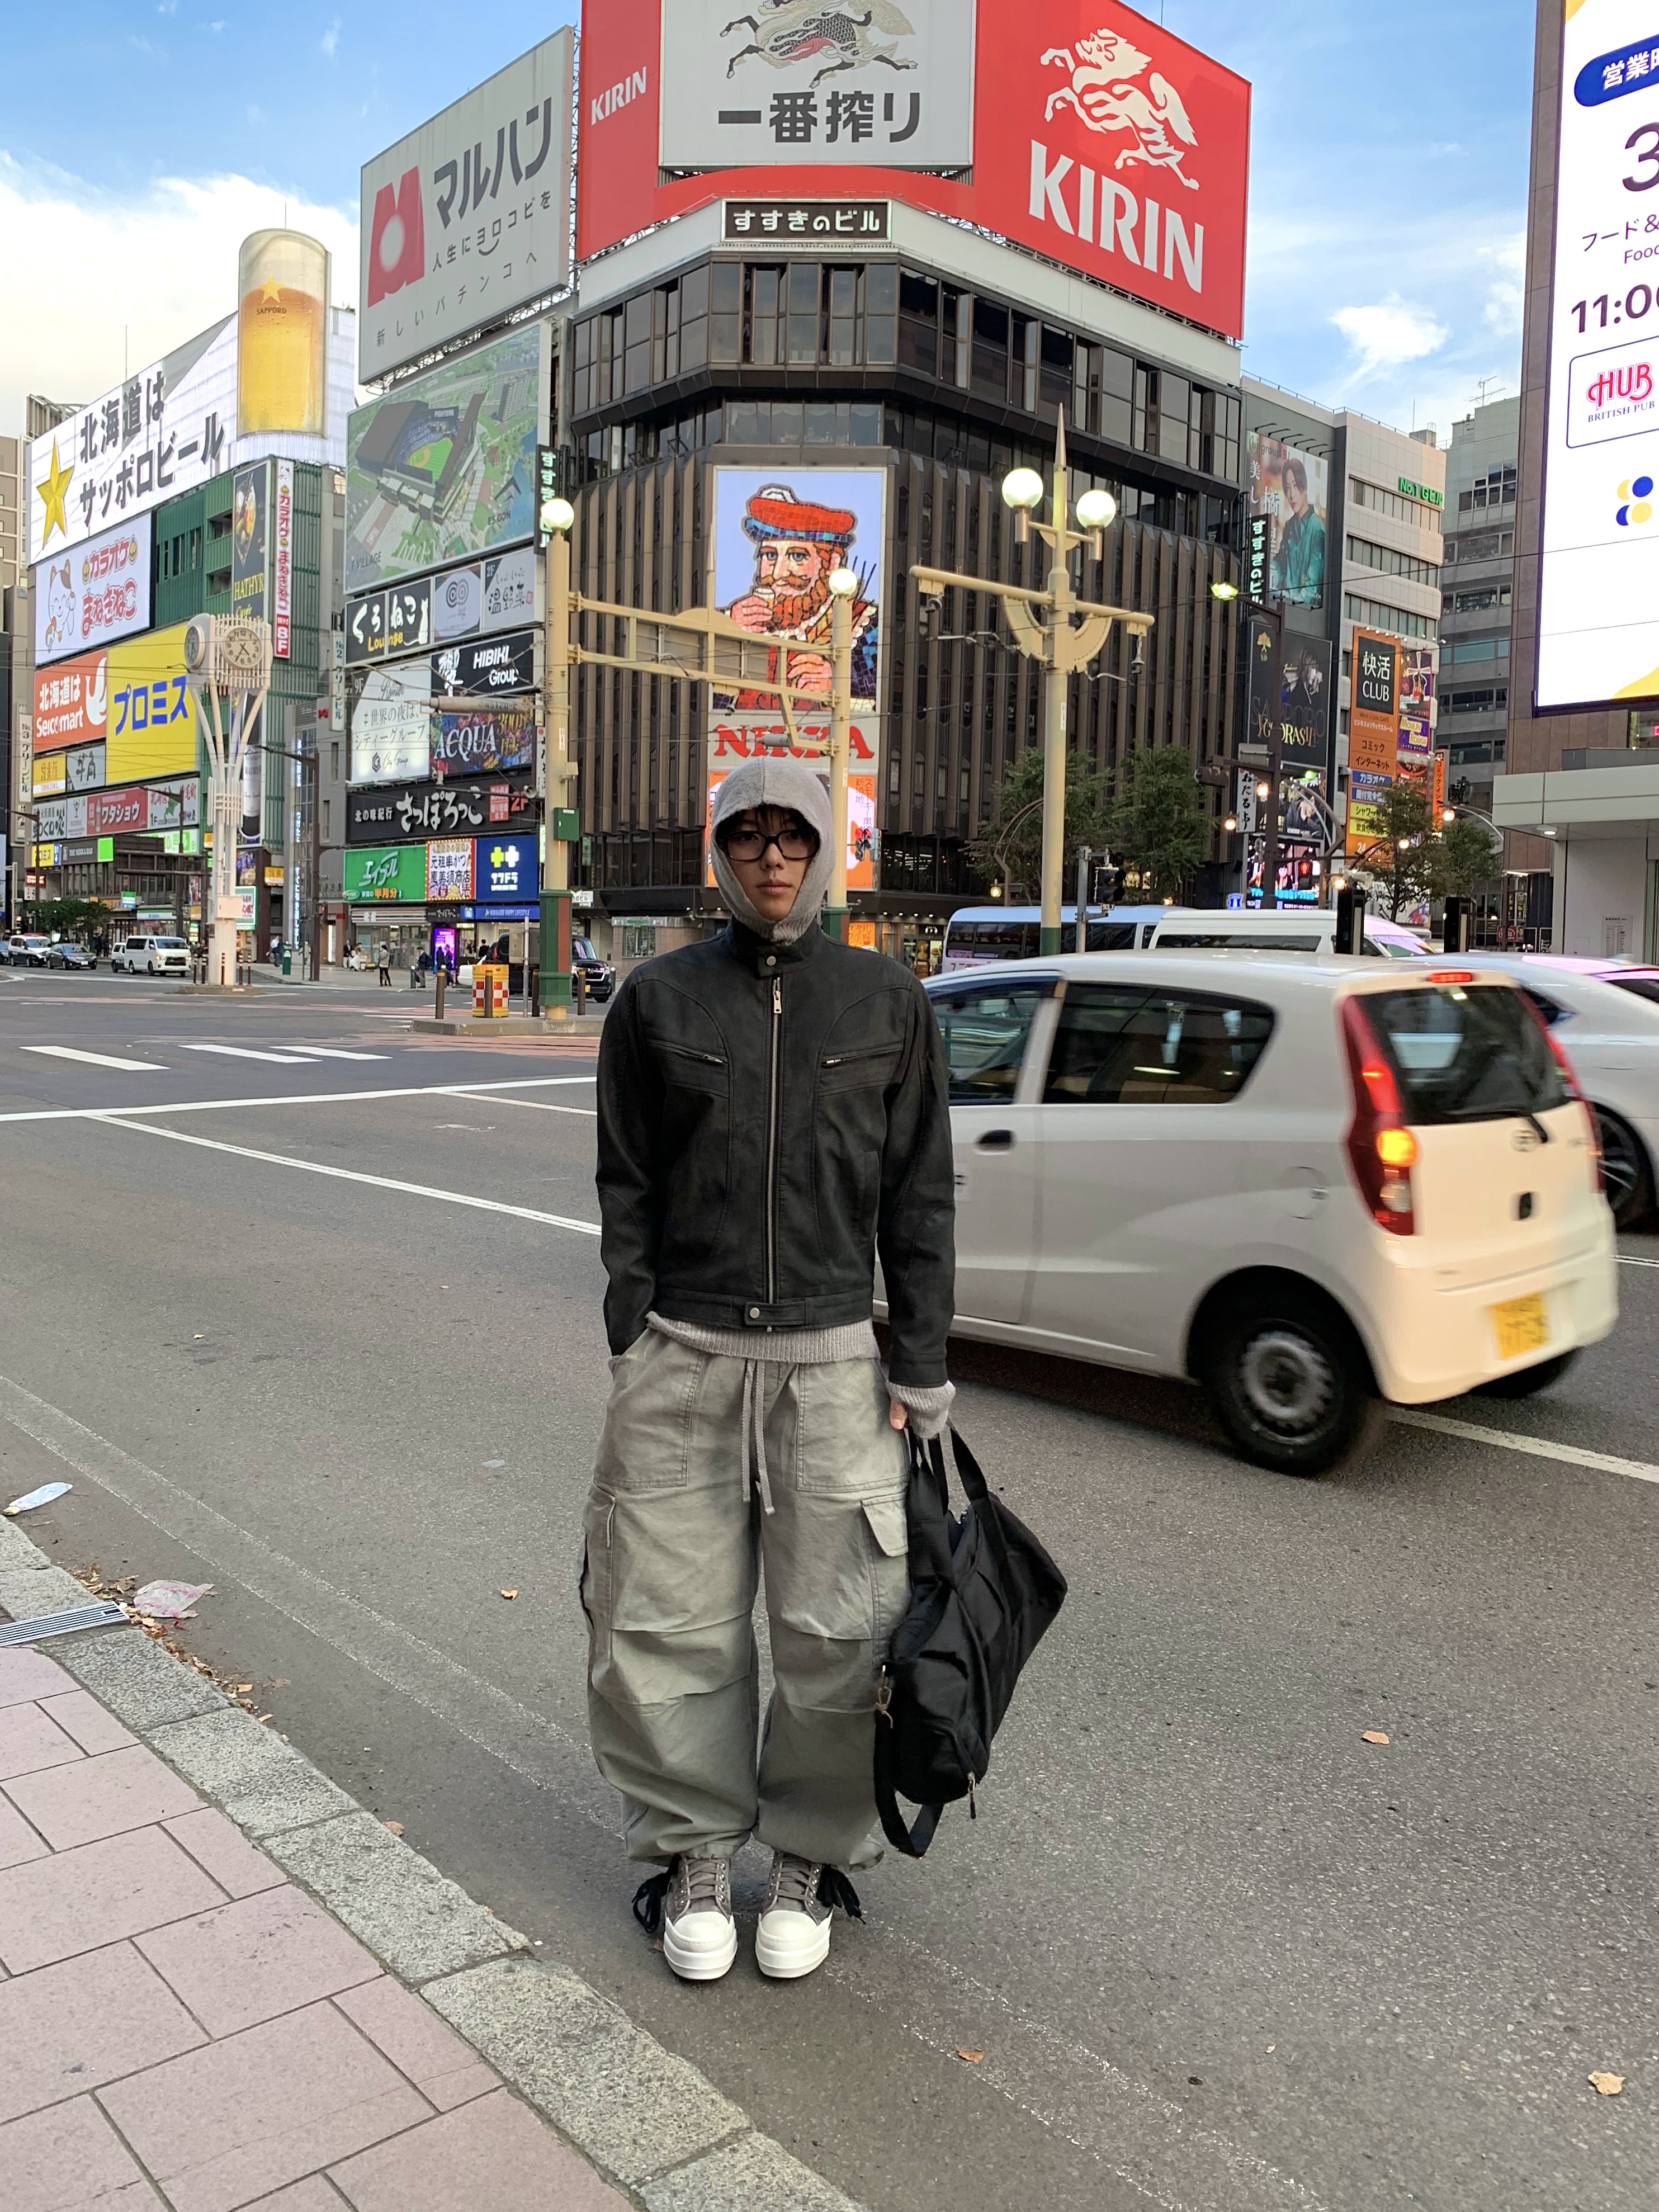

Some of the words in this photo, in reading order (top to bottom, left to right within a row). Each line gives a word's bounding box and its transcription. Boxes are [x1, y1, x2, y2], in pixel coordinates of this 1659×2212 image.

[590, 66, 647, 126] KIRIN
[718, 91, 921, 143] 一番搾り
[434, 96, 552, 230] マルハン
[432, 190, 551, 273] 人生にヨロコビを
[733, 210, 881, 232] すすきのビル
[1029, 139, 1204, 294] KIRIN
[256, 306, 287, 315] SAPPORO
[1571, 284, 1659, 333] 11:0
[1587, 362, 1654, 410] HUB
[80, 370, 167, 464] 北海道は
[1587, 407, 1630, 422] BRITISH
[1634, 400, 1655, 413] PUB
[80, 411, 225, 528] サッポロビール
[279, 494, 291, 538] カラオケ
[89, 537, 130, 584] カラオケ
[356, 551, 382, 570] VILLAGE
[486, 565, 495, 577] 2F
[82, 577, 138, 639] まねきねこ
[352, 593, 417, 644] くろねこ
[277, 626, 289, 653] 8F
[367, 631, 404, 653] Lounge
[473, 645, 510, 669] HIBIKI
[1363, 650, 1391, 680] 快活
[489, 668, 519, 686] Group
[1362, 680, 1390, 702] CLUB
[39, 674, 81, 712] 北海道は
[114, 675, 189, 736] プロミス
[434, 724, 497, 762] ACQUA
[1362, 740, 1385, 753] コミック
[1355, 755, 1390, 771] インターネット
[1360, 773, 1385, 784] カラオケ
[101, 801, 140, 825] ワタショウ
[150, 812, 157, 826] 1F
[355, 807, 393, 823] 北の味紀行
[358, 851, 399, 887] エイブル
[431, 854, 466, 869] 元祖串かつ
